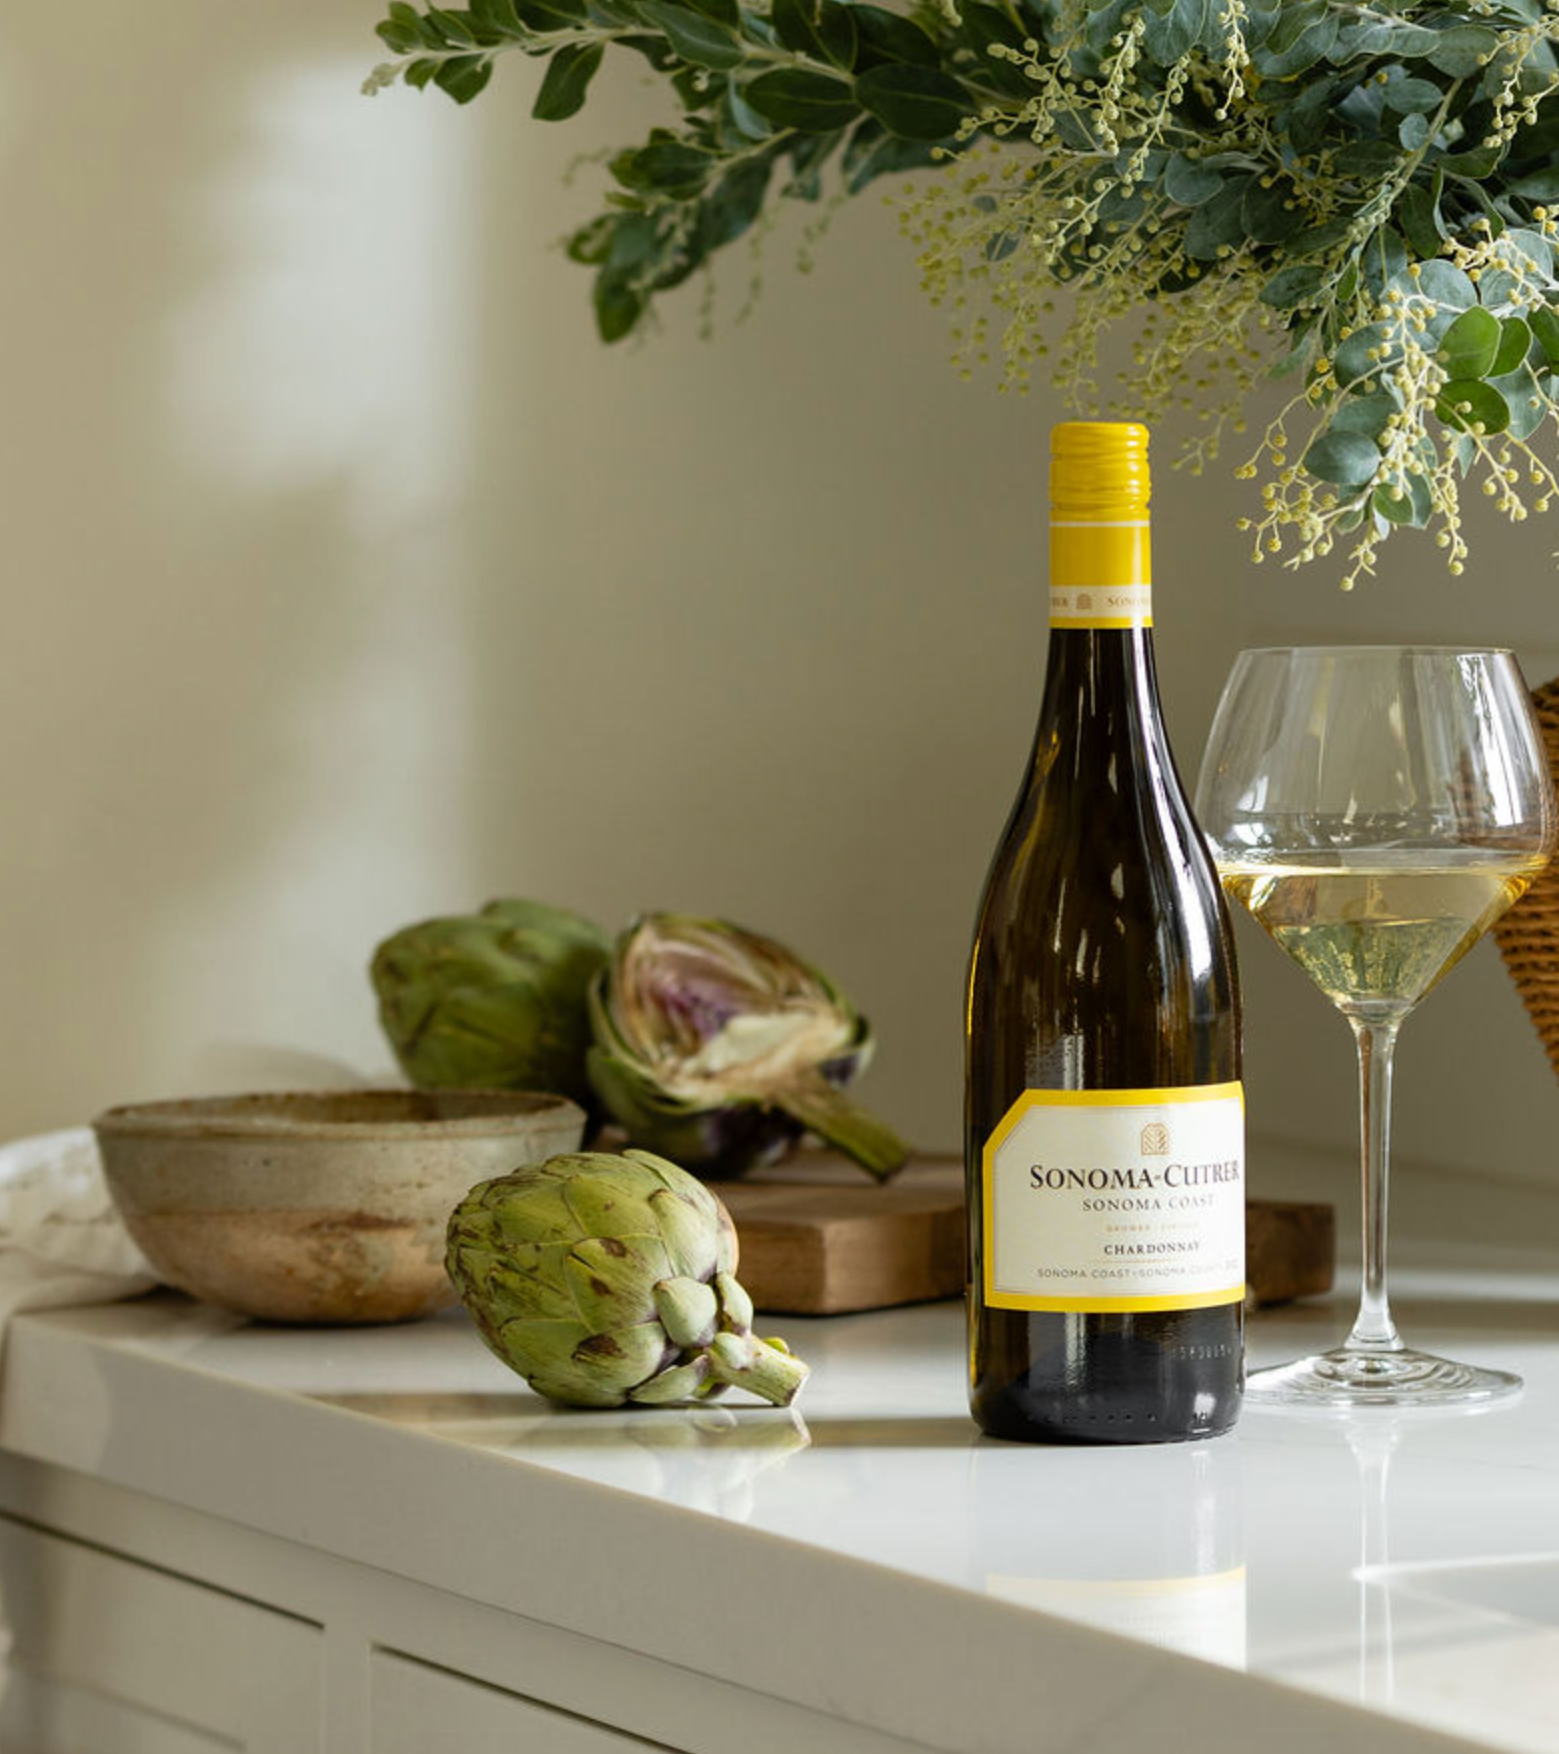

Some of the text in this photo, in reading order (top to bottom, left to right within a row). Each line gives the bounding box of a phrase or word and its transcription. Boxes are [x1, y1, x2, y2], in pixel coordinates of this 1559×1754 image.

[1030, 1160, 1239, 1190] SONOMA-CUTRER
[1082, 1193, 1215, 1212] SONOMA COAST
[1104, 1241, 1200, 1256] CHARDONNAY
[1037, 1268, 1086, 1278] SONOMA
